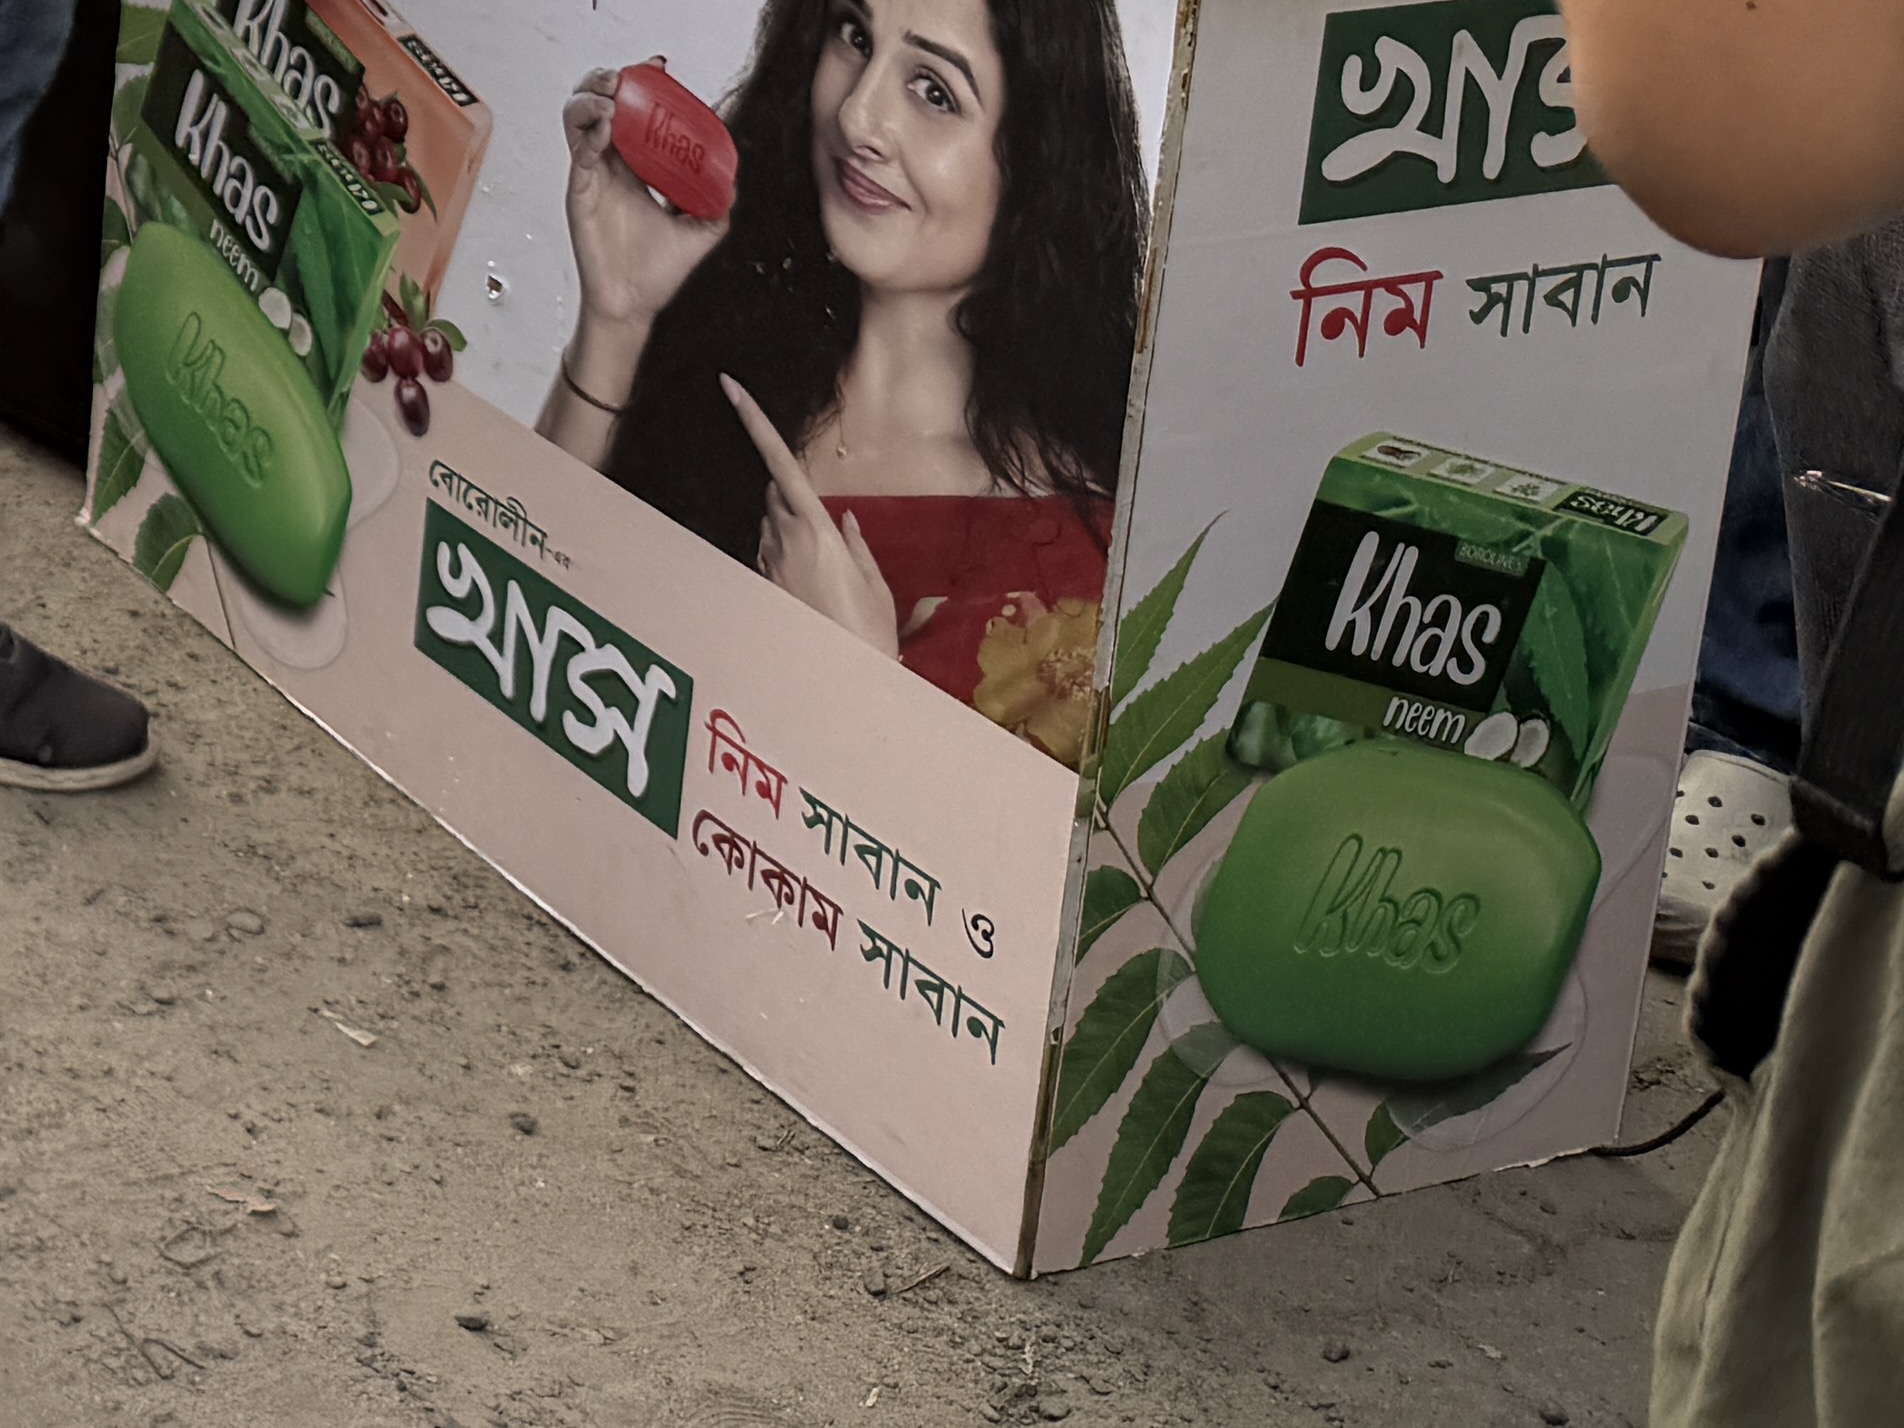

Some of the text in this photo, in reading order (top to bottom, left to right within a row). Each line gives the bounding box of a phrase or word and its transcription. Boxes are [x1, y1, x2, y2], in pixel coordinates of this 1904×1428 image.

[175, 70, 281, 252] Khas
[209, 217, 261, 292] neem
[1290, 247, 1662, 367] নিম সাবান
[1324, 530, 1502, 685] Khas
[1383, 695, 1466, 743] neem
[703, 707, 995, 959] নিম সাবান ও
[692, 809, 1005, 1065] কোকাম সাবান
